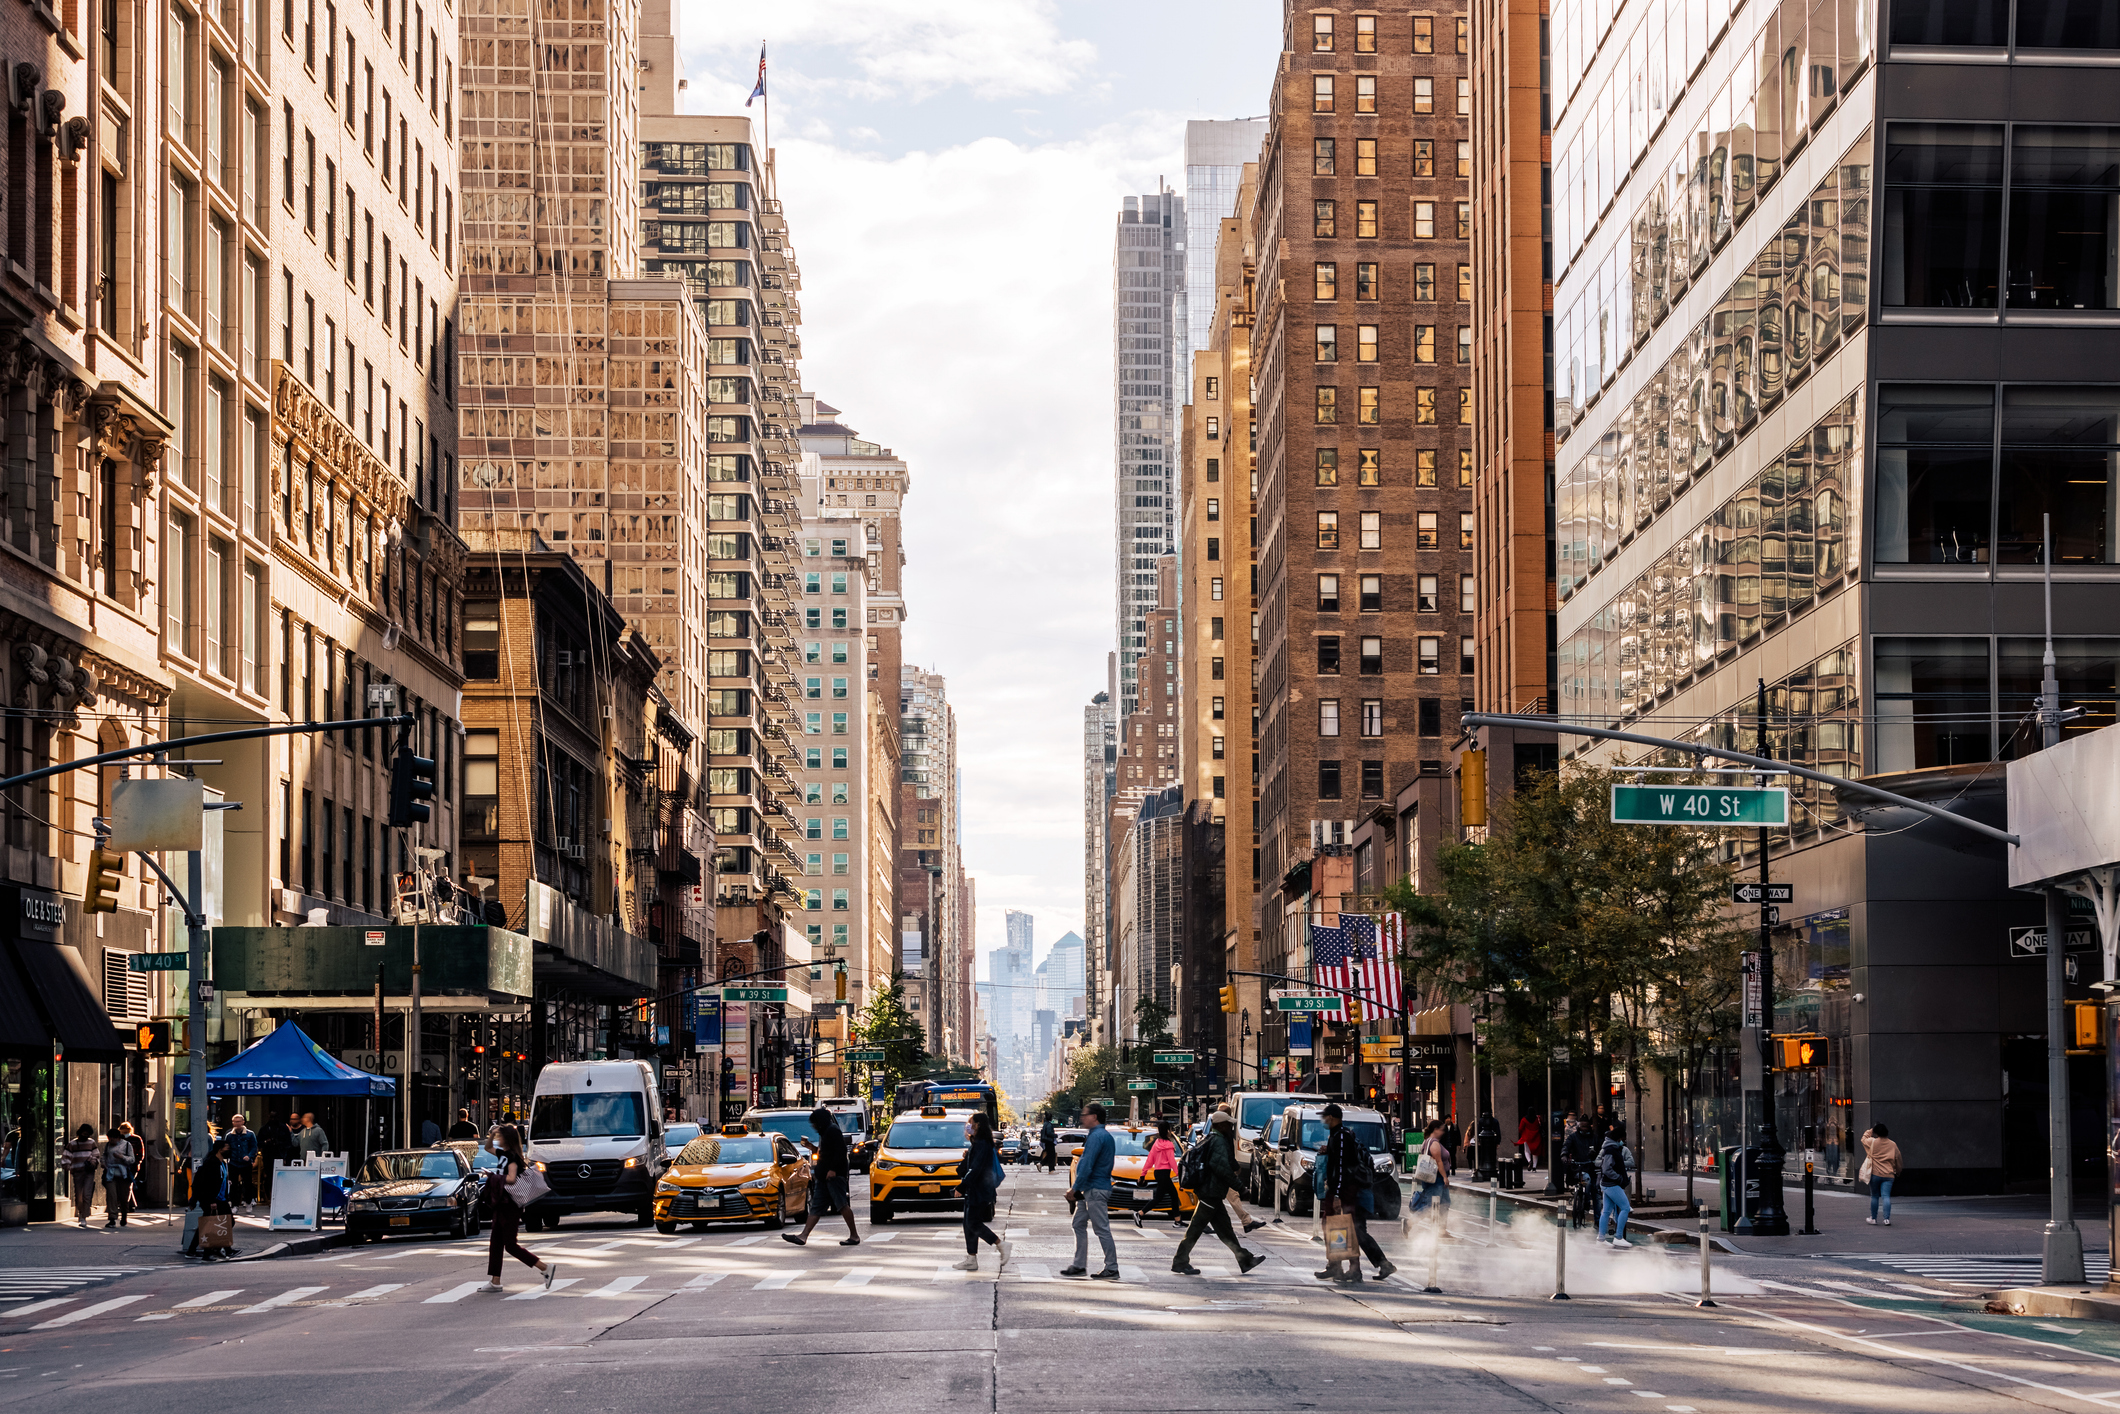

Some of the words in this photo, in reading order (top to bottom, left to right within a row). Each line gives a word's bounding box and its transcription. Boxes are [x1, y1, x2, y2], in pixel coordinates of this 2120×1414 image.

[1660, 794, 1675, 815] W
[1683, 795, 1710, 816] 40
[1719, 795, 1740, 817] St
[1742, 889, 1760, 898] ONE
[26, 897, 39, 920] OLE
[40, 900, 45, 921] &
[46, 901, 67, 924] STEEN
[2024, 935, 2047, 947] ONE
[142, 956, 152, 968] W
[155, 955, 172, 968] 40
[740, 991, 746, 999] W
[749, 991, 759, 999] 39
[761, 991, 770, 999] St
[1295, 1000, 1302, 1008] W
[1304, 1000, 1314, 1008] 39
[1316, 1000, 1325, 1008] St
[1431, 1044, 1451, 1055] Inn
[355, 1054, 397, 1069] 100
[223, 1081, 237, 1090] 19
[240, 1081, 289, 1090] TESTING
